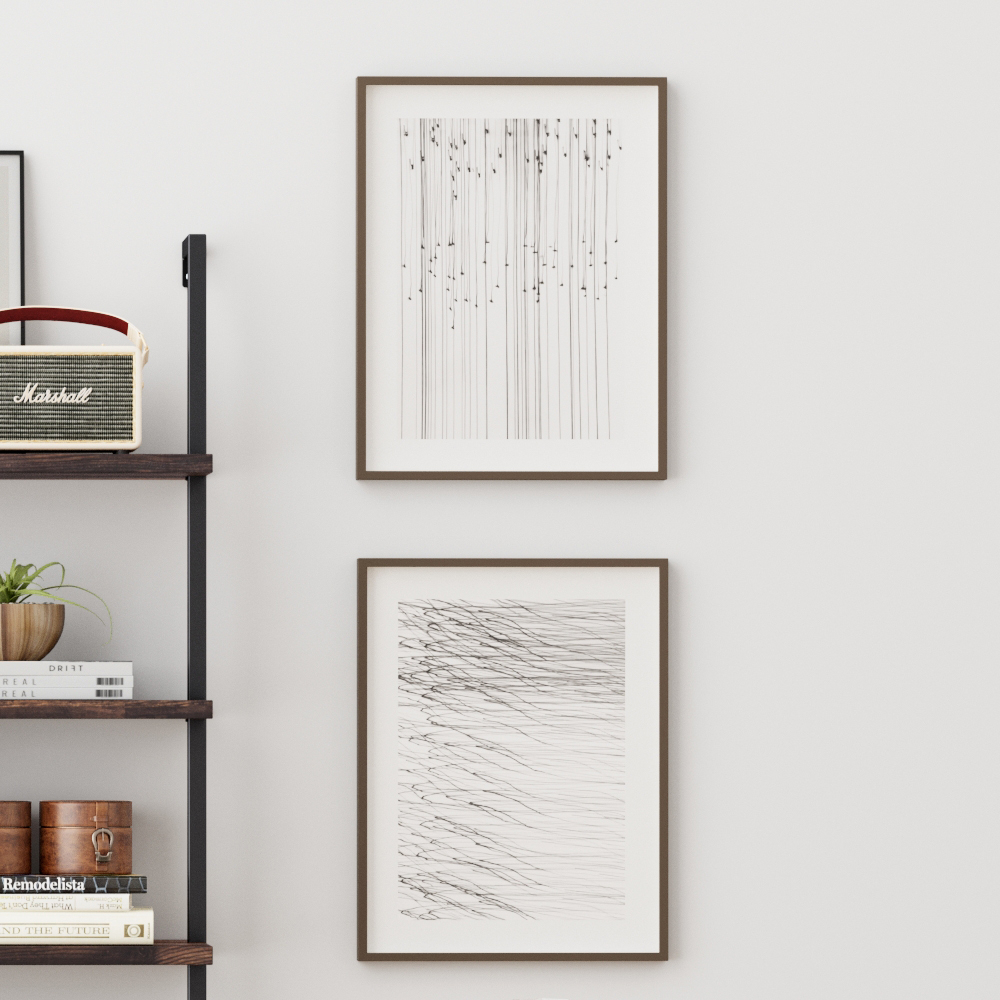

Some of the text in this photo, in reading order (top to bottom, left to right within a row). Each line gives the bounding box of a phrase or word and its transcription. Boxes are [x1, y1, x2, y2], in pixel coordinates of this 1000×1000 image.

[13, 382, 93, 404] Marshall
[2, 876, 86, 892] Remodelista
[25, 926, 53, 935] THE
[58, 926, 111, 935] FUTURE
